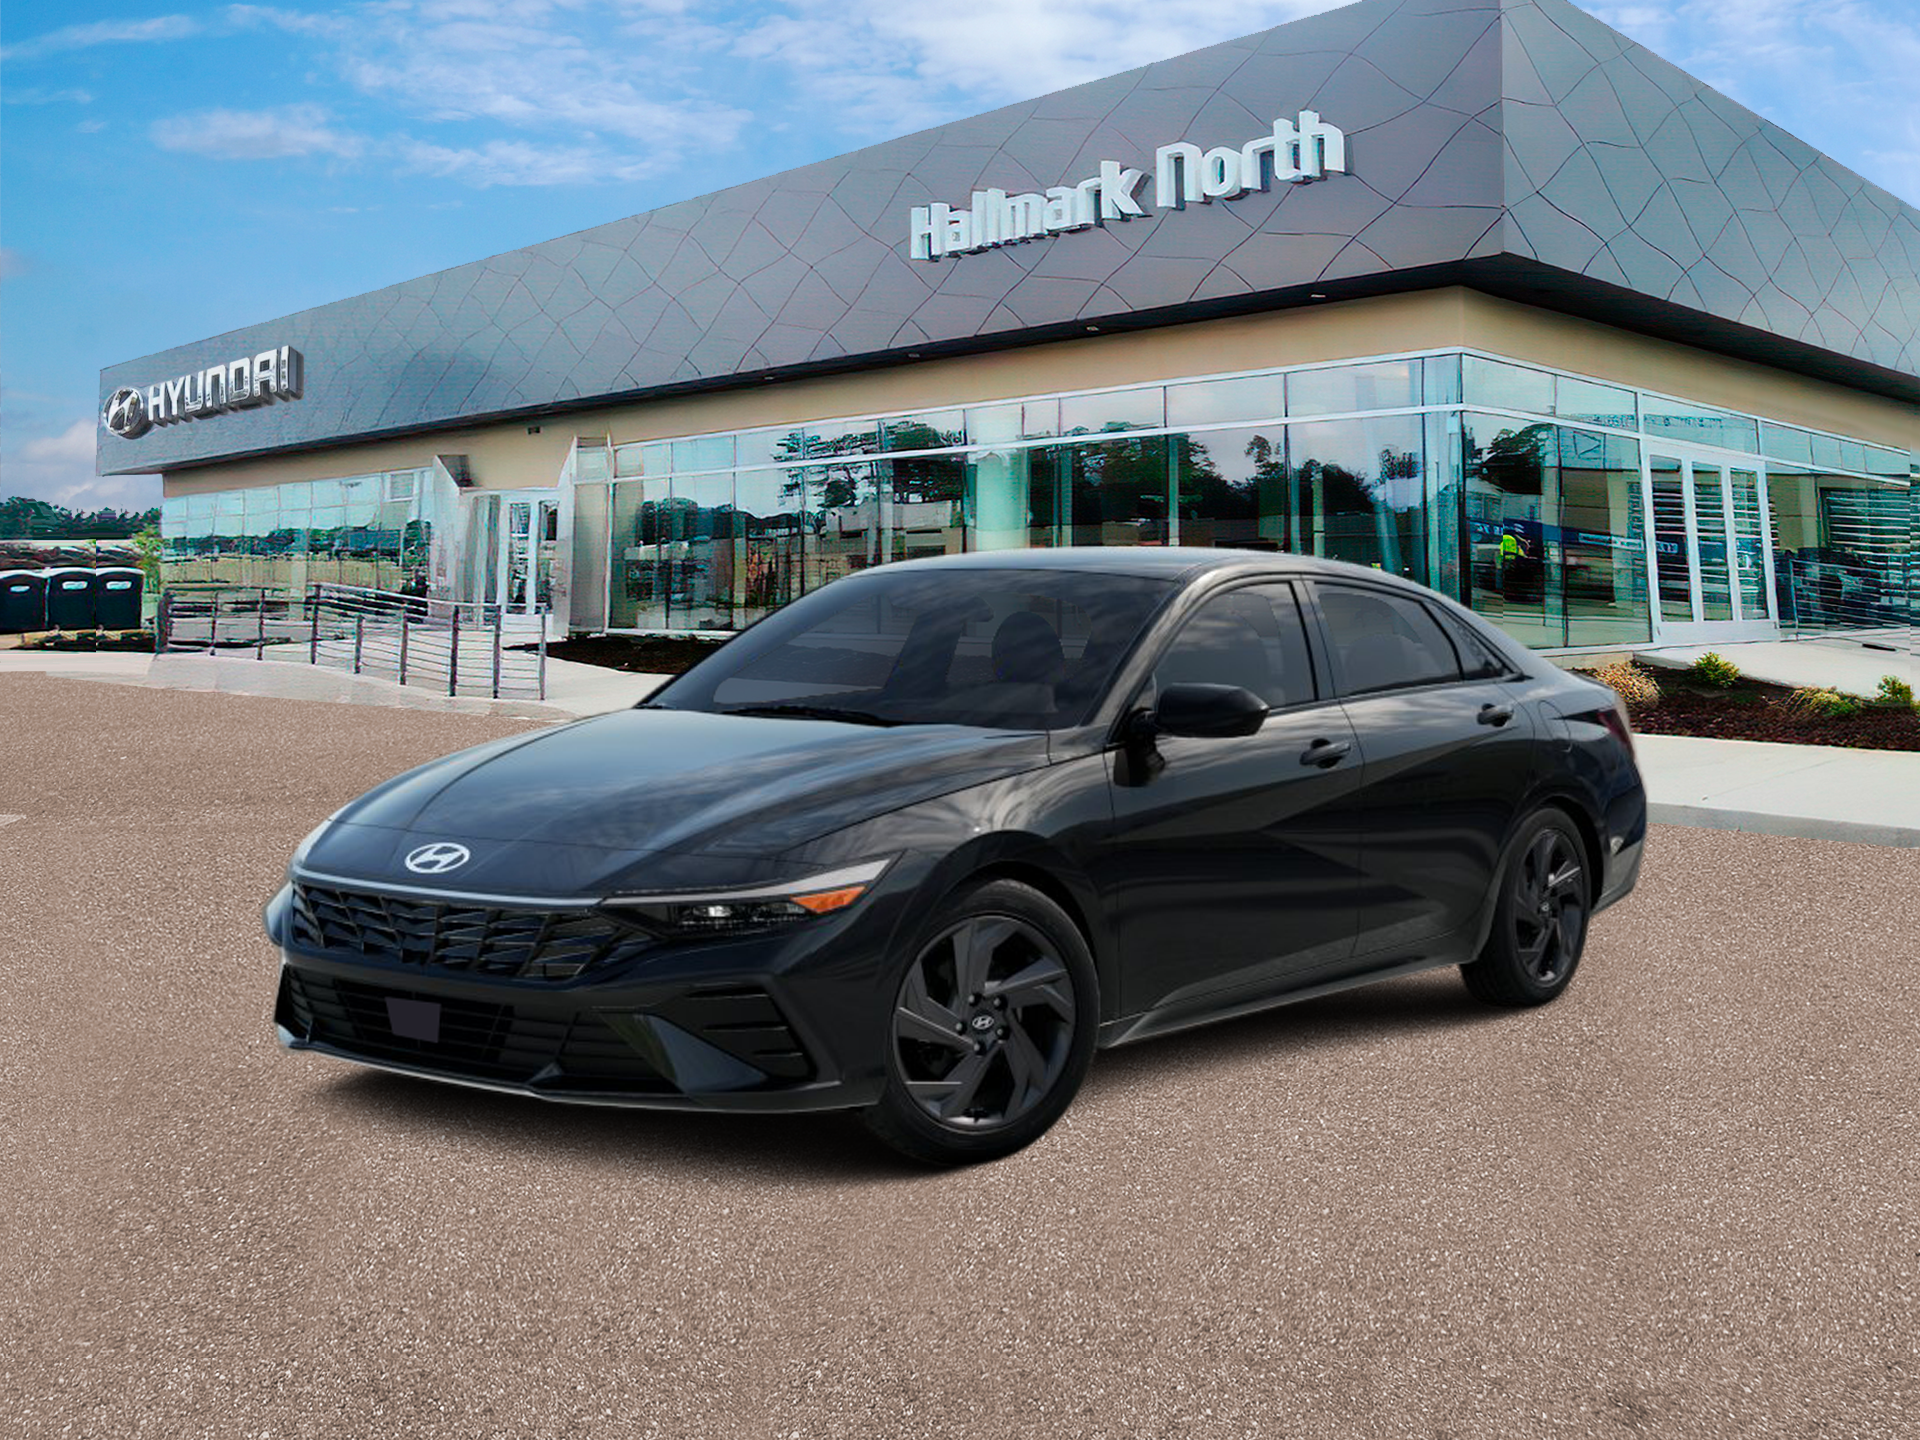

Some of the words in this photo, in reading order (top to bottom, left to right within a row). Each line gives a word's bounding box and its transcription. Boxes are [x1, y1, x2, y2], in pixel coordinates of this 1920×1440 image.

[908, 159, 1148, 261] Hallmark
[1156, 109, 1347, 209] North
[147, 345, 294, 423] HYUNDAI
